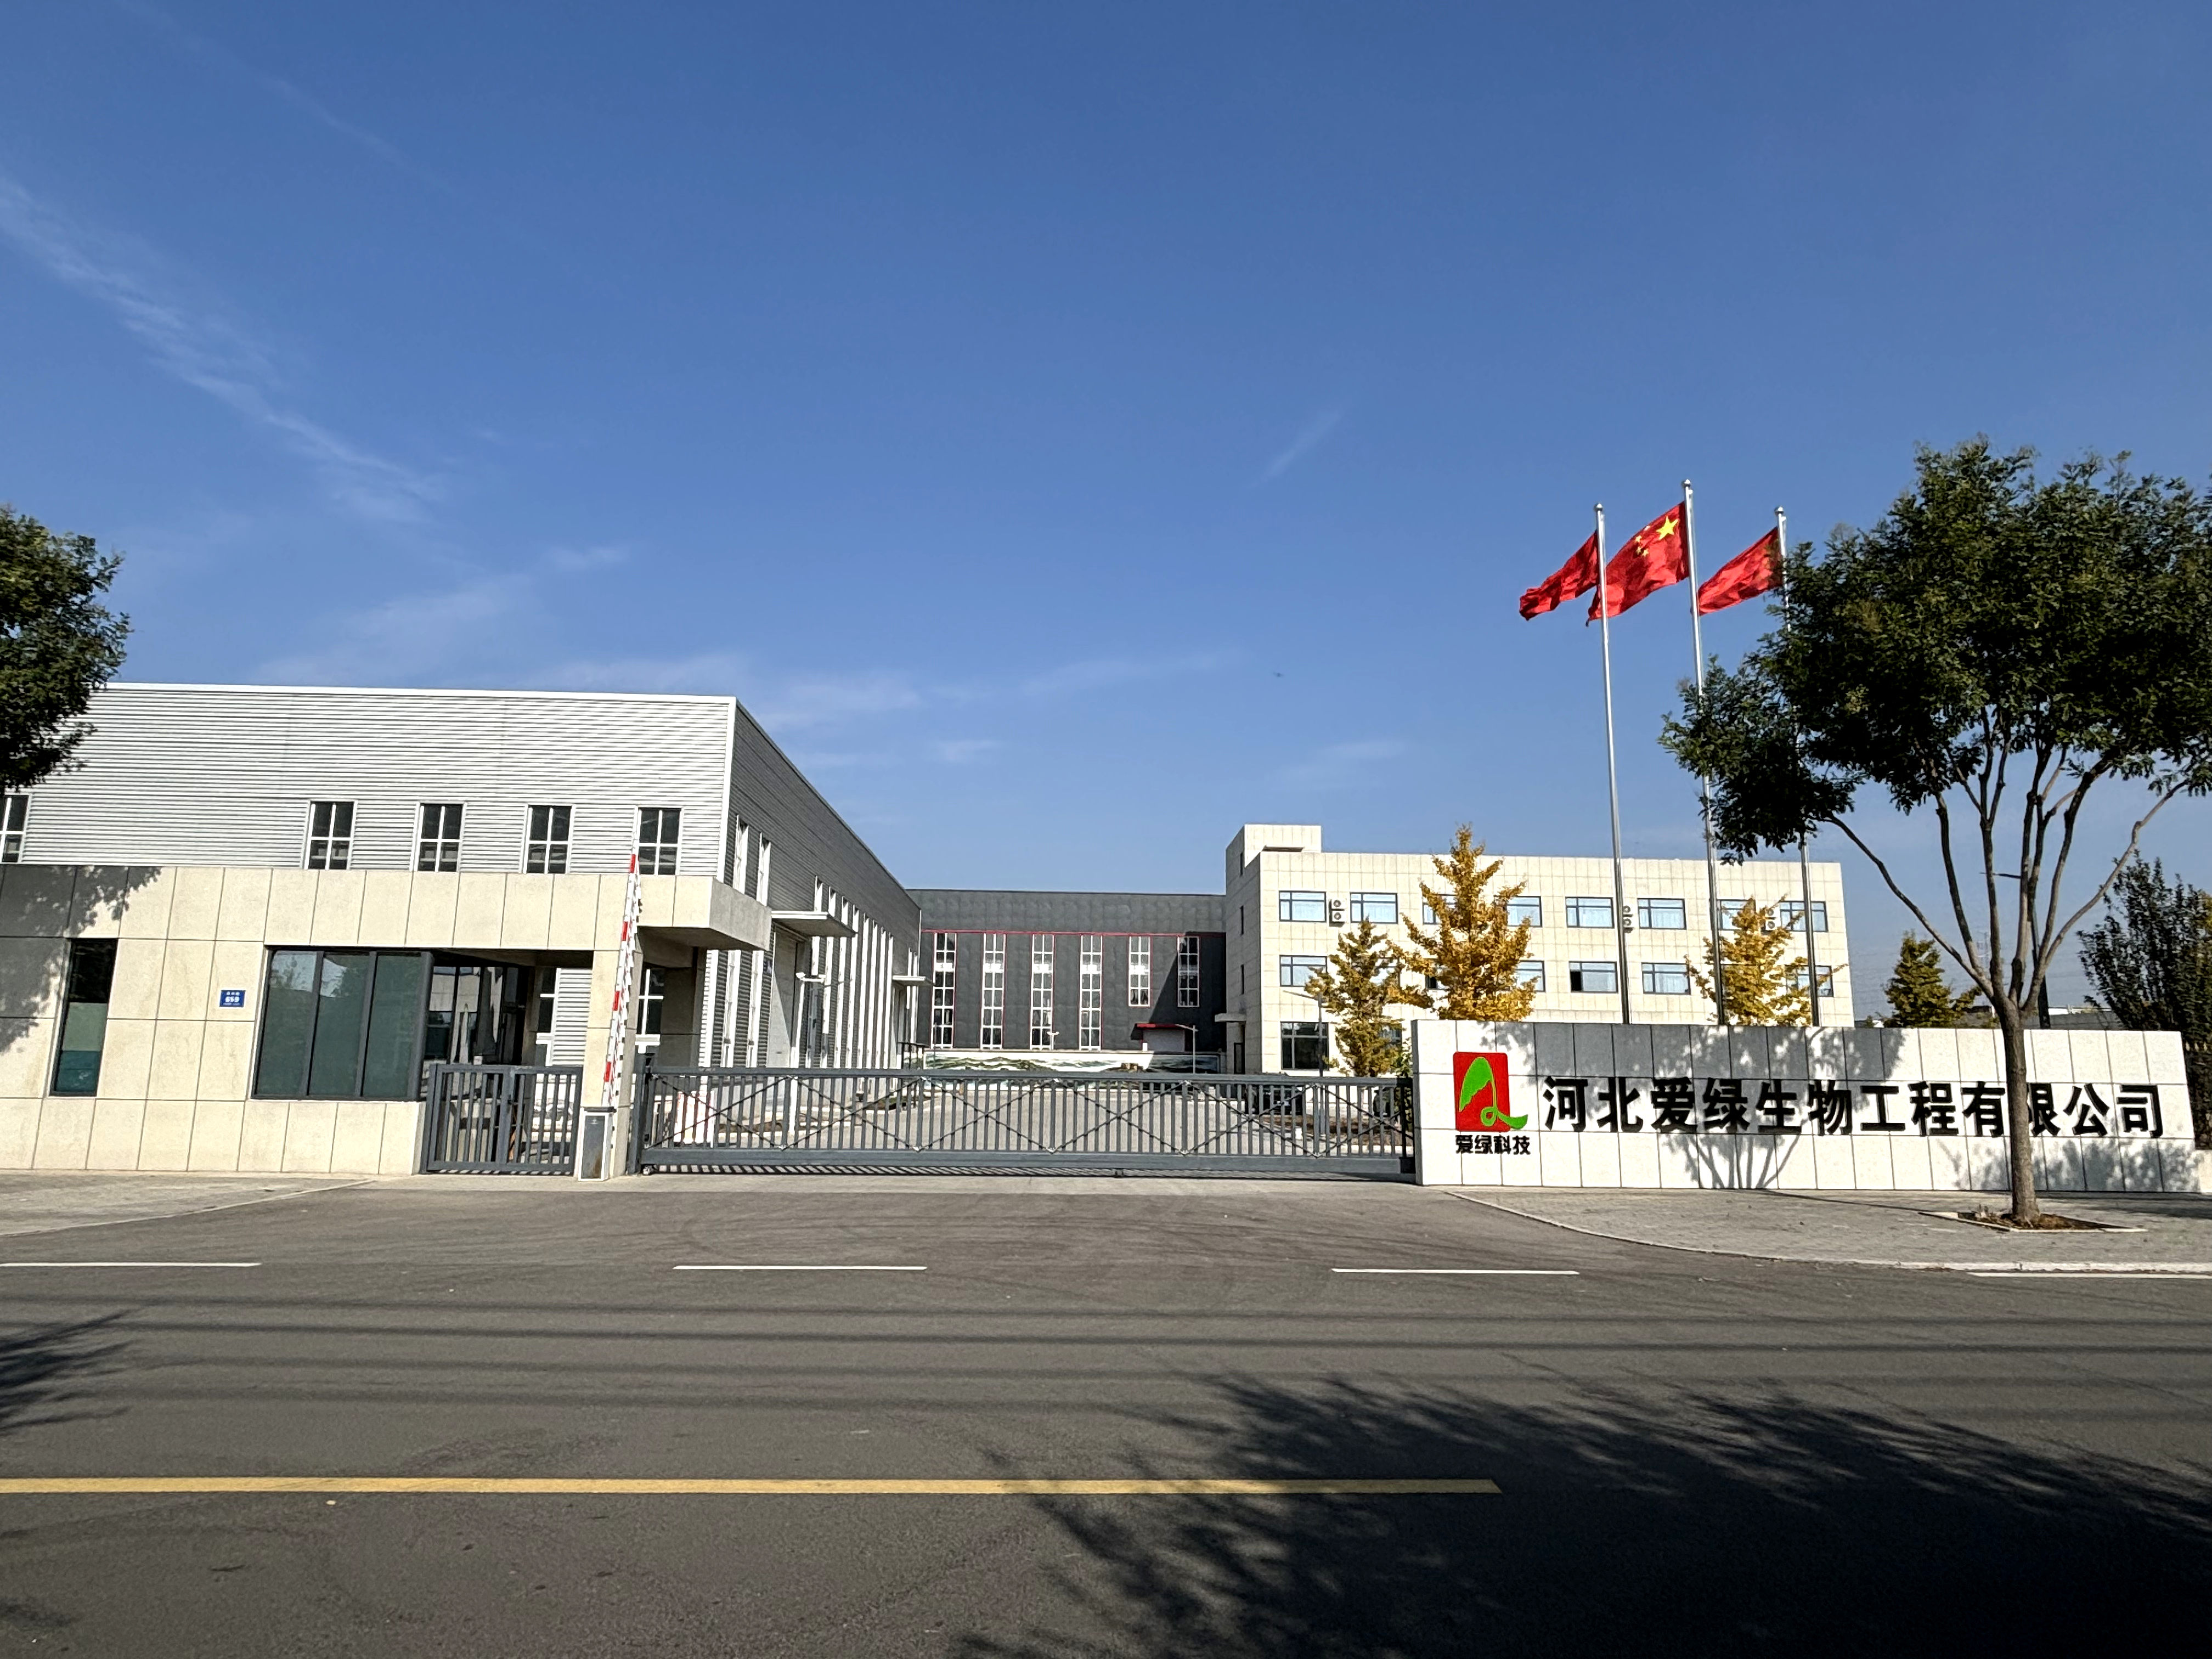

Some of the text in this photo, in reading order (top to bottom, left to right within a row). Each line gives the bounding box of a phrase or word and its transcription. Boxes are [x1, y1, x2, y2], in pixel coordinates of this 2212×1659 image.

[1543, 1075, 2163, 1137] 河北爱绿生物工程有限公司
[1455, 1134, 1531, 1155] 爱绿科技
